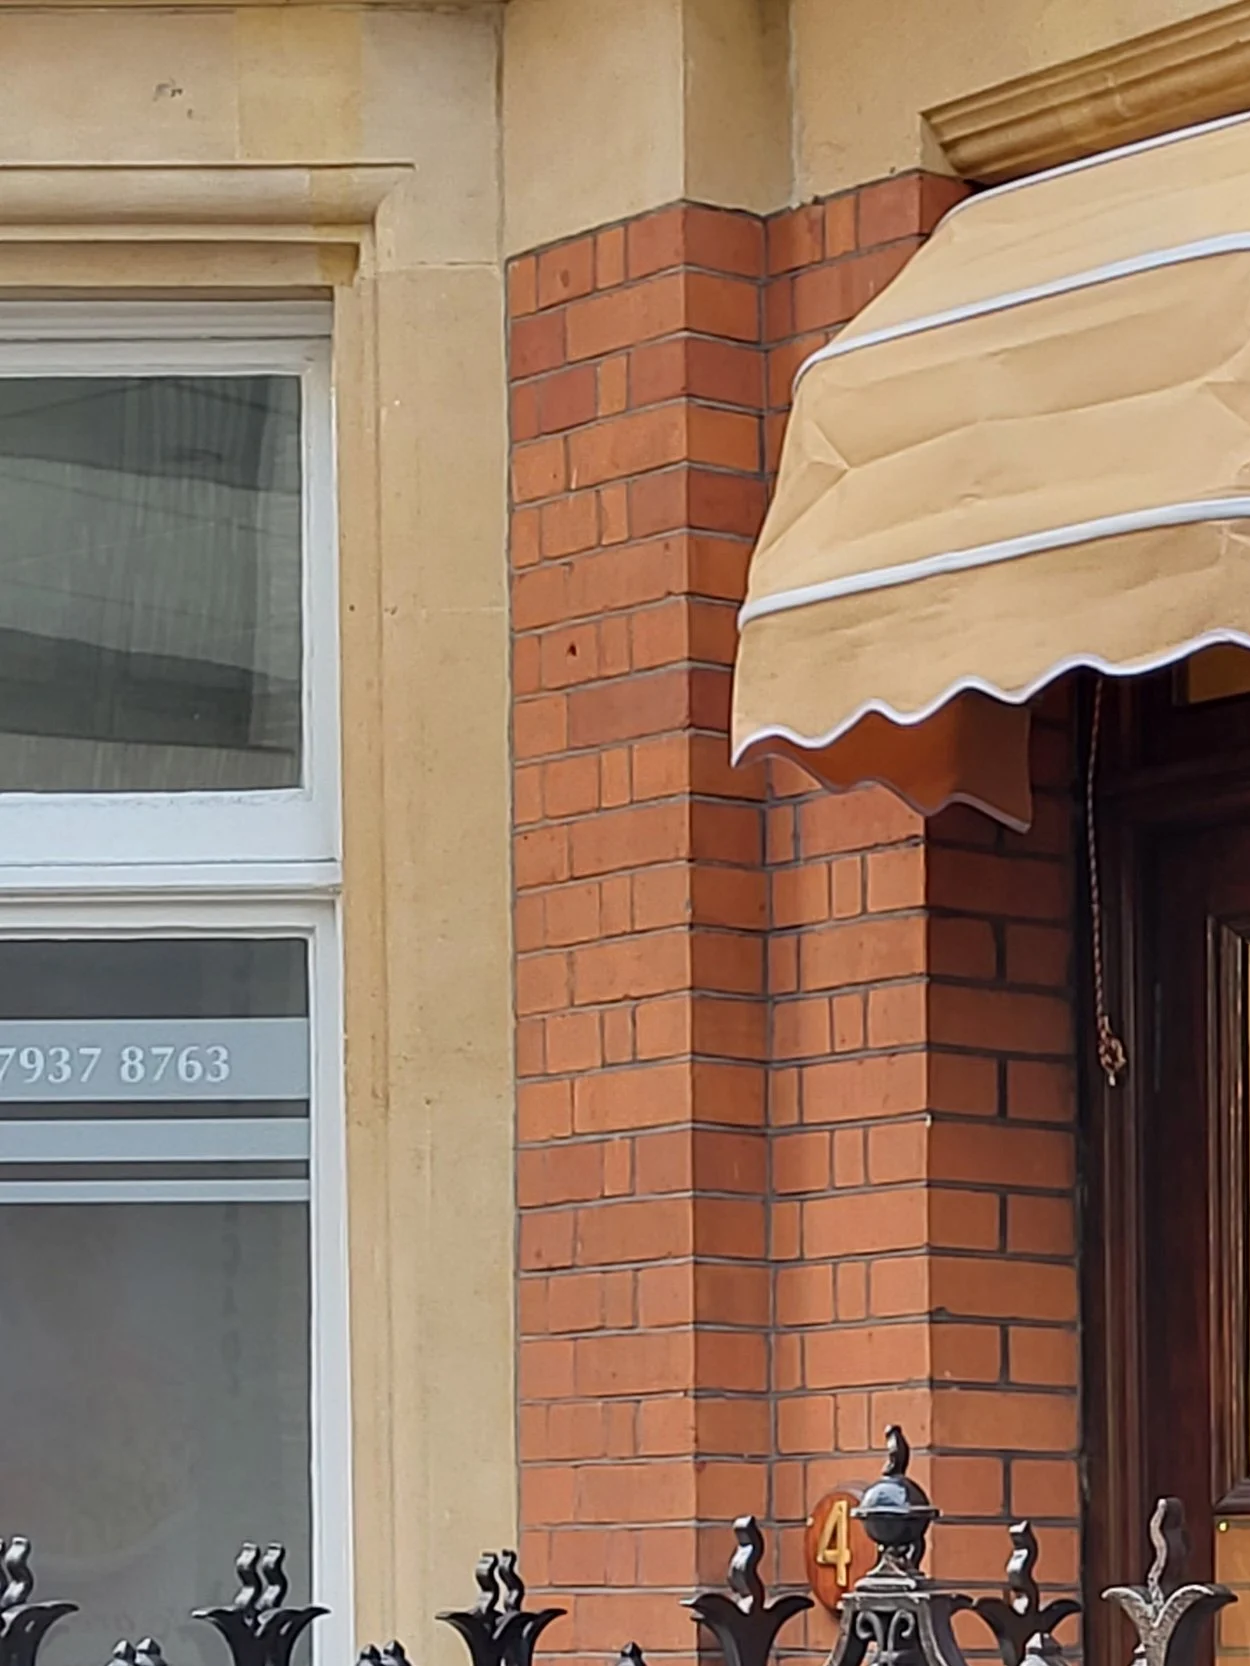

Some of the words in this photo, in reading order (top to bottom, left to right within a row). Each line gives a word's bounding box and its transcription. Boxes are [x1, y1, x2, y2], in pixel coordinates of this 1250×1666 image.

[0, 1047, 102, 1083] 7937
[120, 1046, 230, 1083] 8763
[816, 1499, 851, 1587] 4
